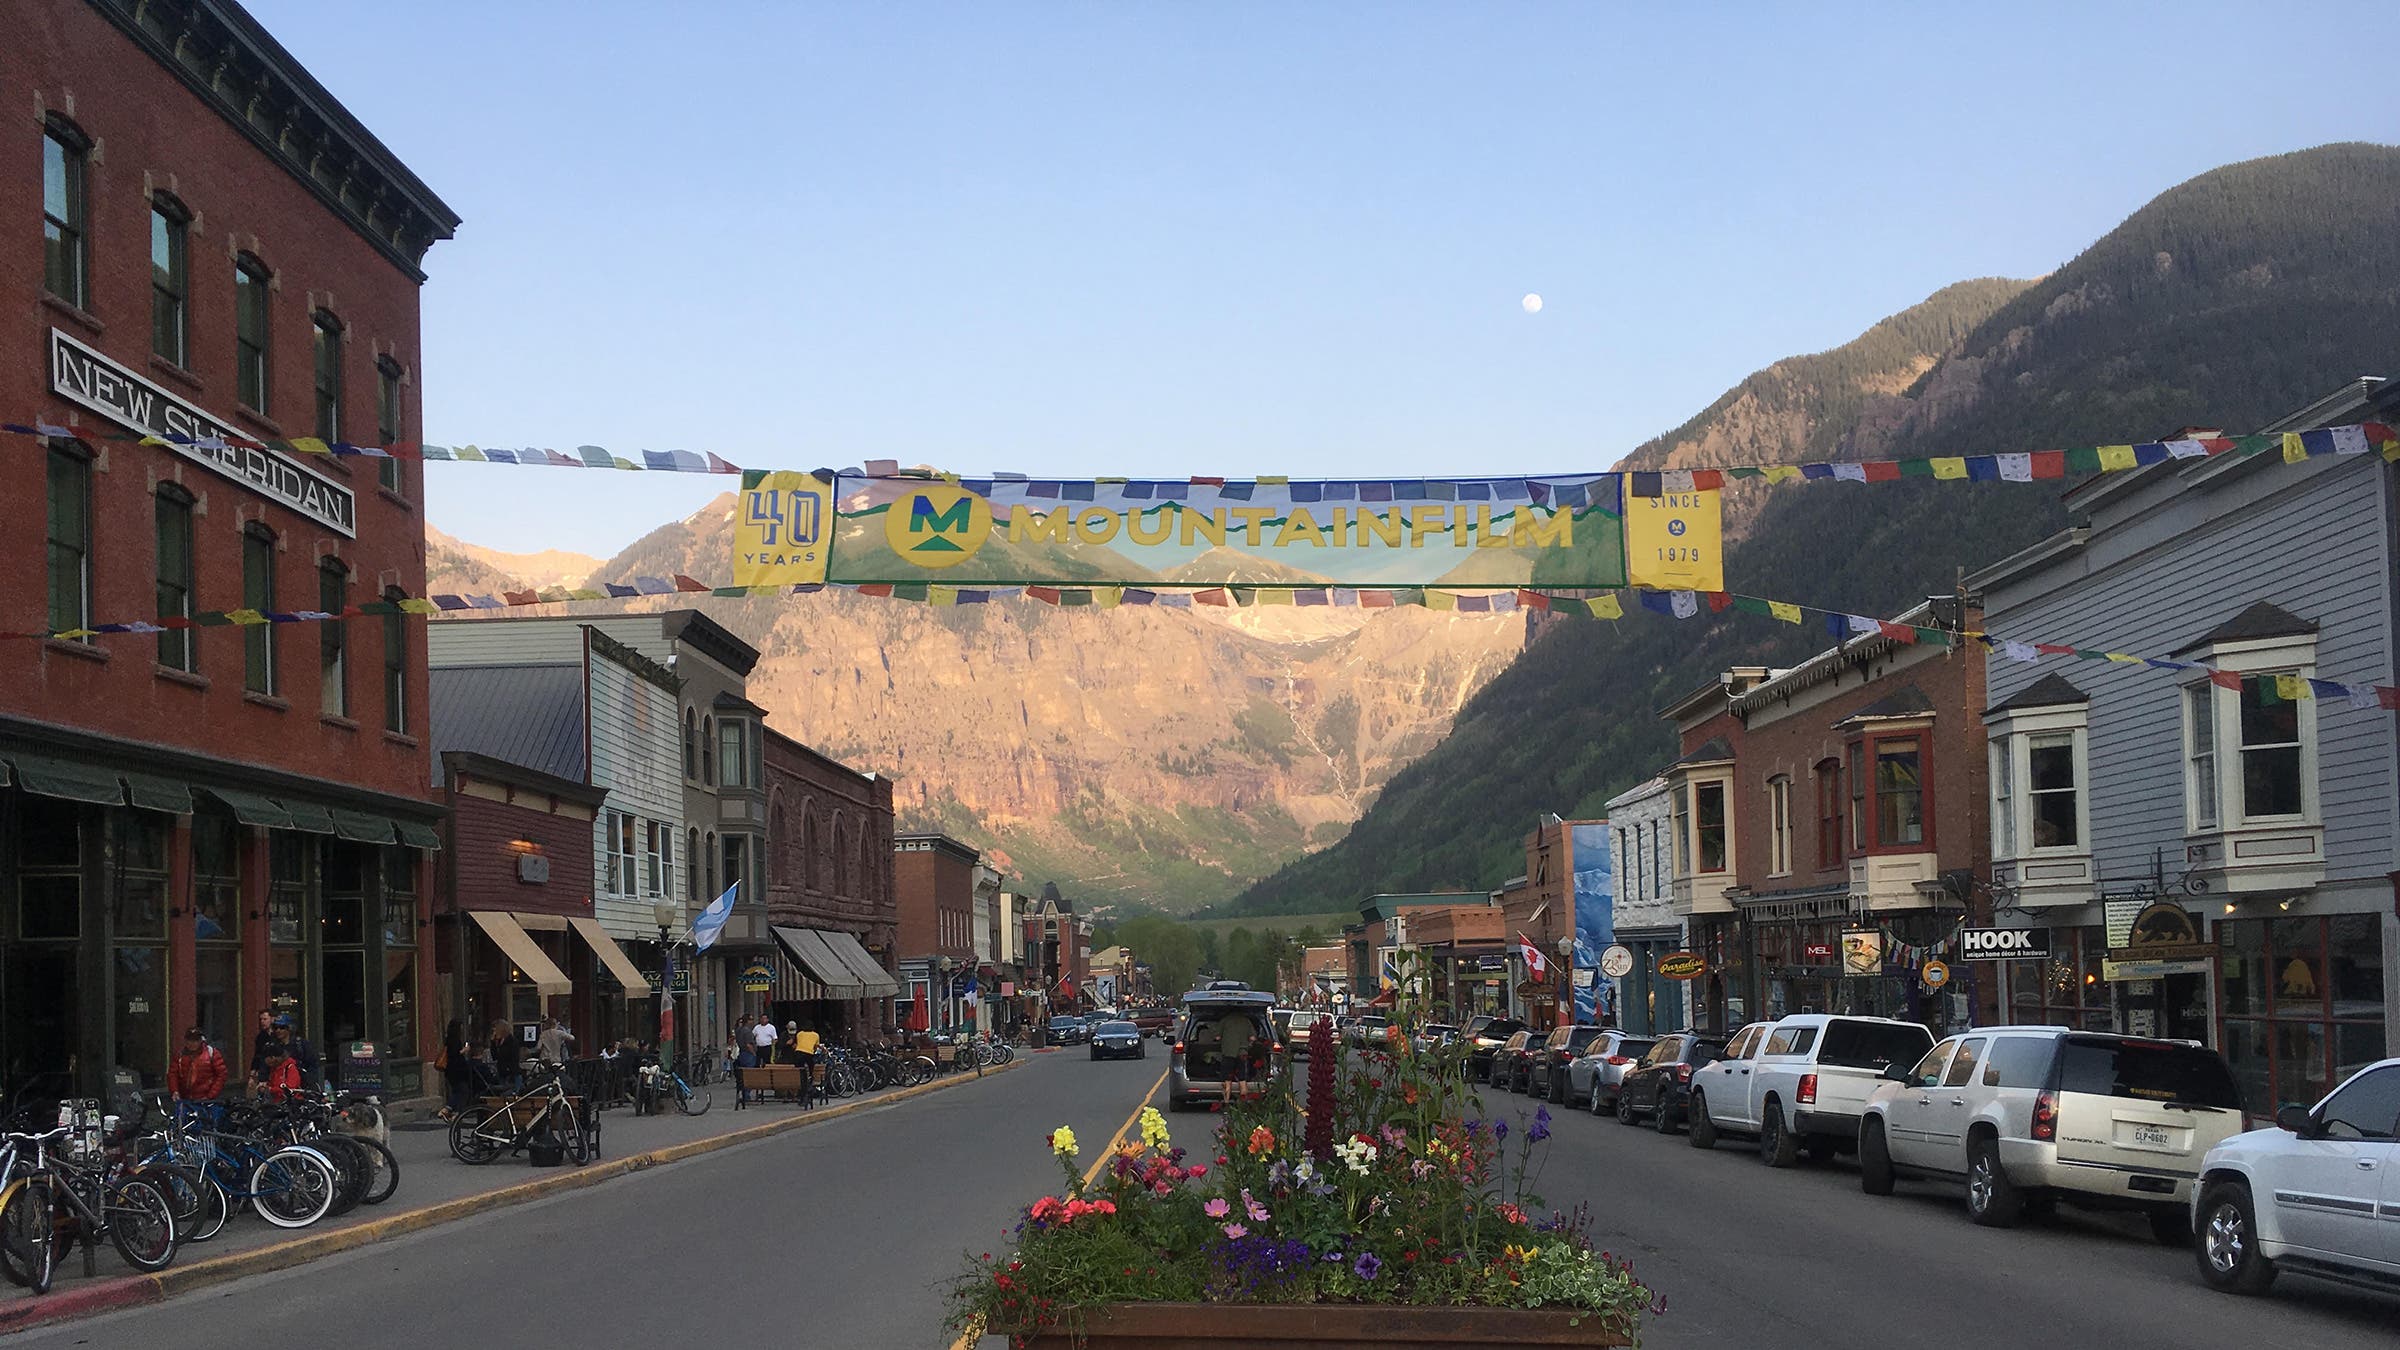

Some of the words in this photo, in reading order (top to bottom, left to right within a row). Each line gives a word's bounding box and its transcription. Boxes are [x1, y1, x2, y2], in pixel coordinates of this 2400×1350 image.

[60, 346, 153, 427] NEW
[1650, 495, 1701, 508] SINCE
[745, 489, 821, 547] 40
[1008, 504, 1574, 548] MOUNTAINFILM
[744, 551, 815, 566] YEARS
[1657, 548, 1699, 561] 1979
[1964, 931, 2032, 949] HOOK
[2022, 949, 2047, 957] hardware
[1660, 959, 1704, 973] Paradise
